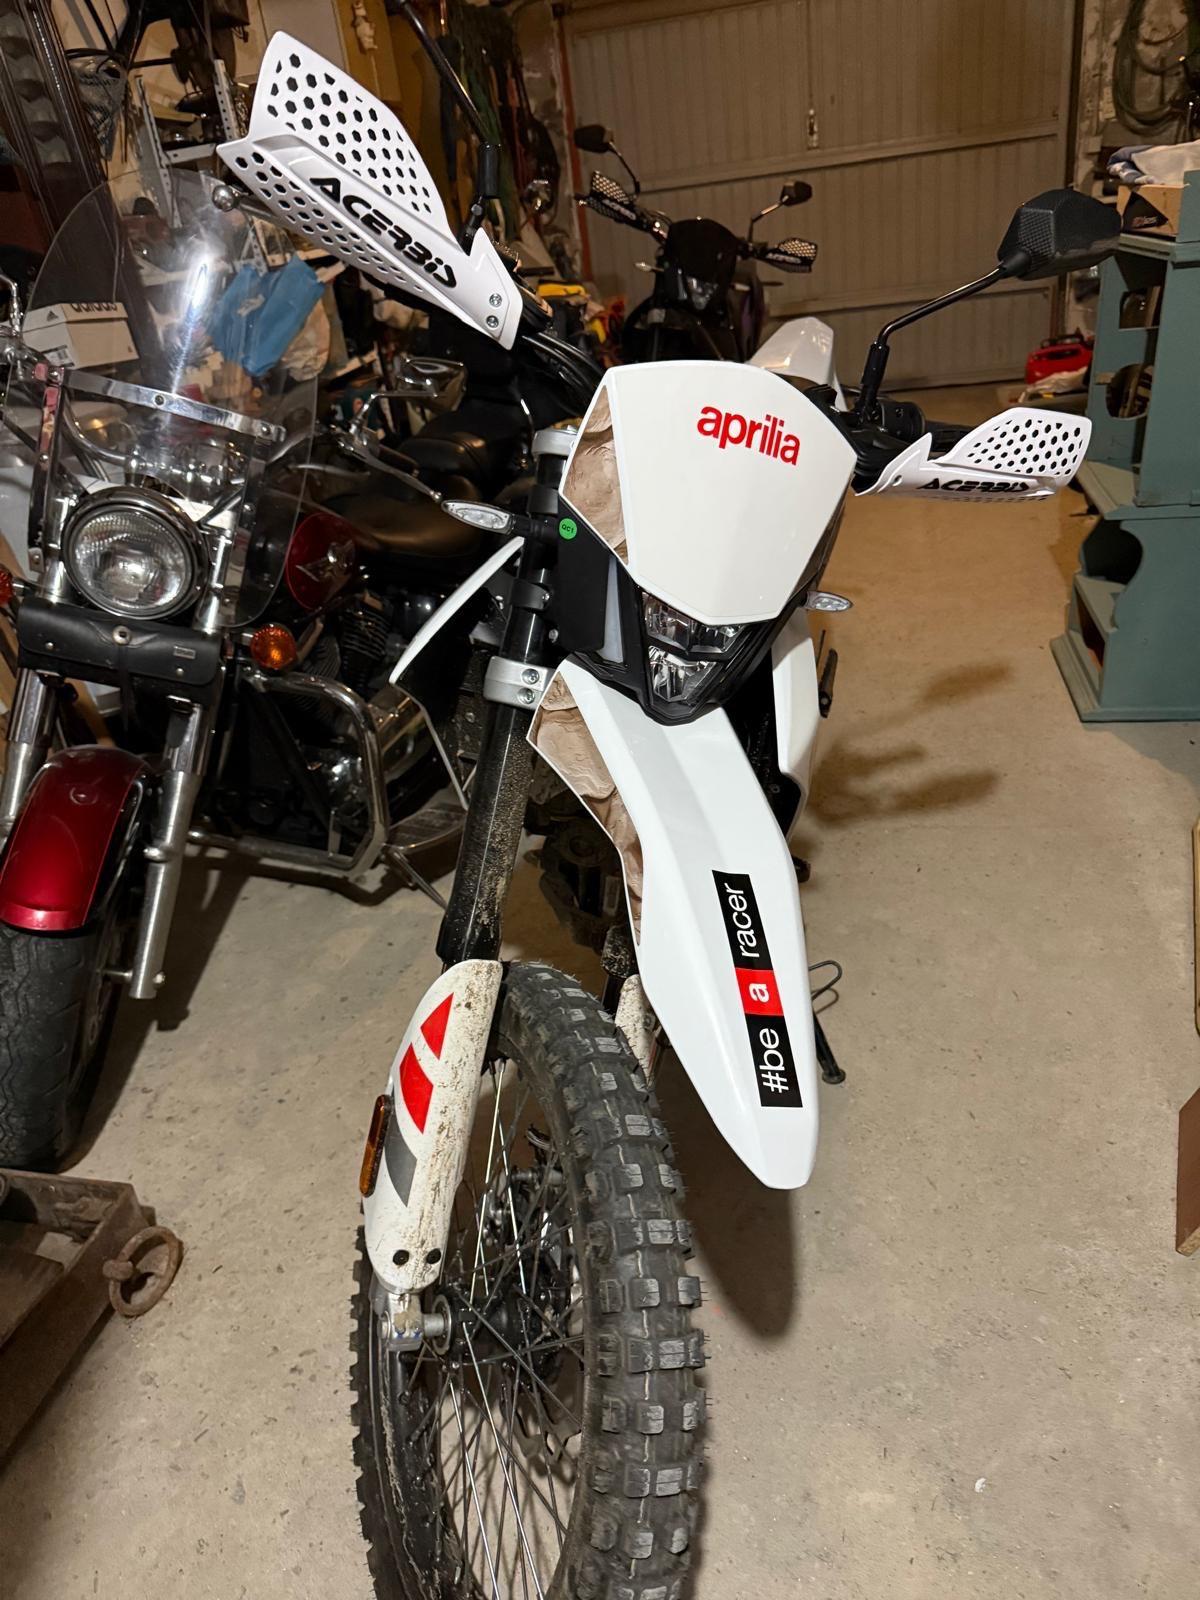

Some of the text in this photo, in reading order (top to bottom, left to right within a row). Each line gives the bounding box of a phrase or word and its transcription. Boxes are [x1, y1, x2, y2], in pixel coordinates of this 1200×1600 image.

[309, 178, 457, 288] ACERBIS
[697, 406, 800, 466] aprilia
[724, 882, 789, 1093] #be a racer
